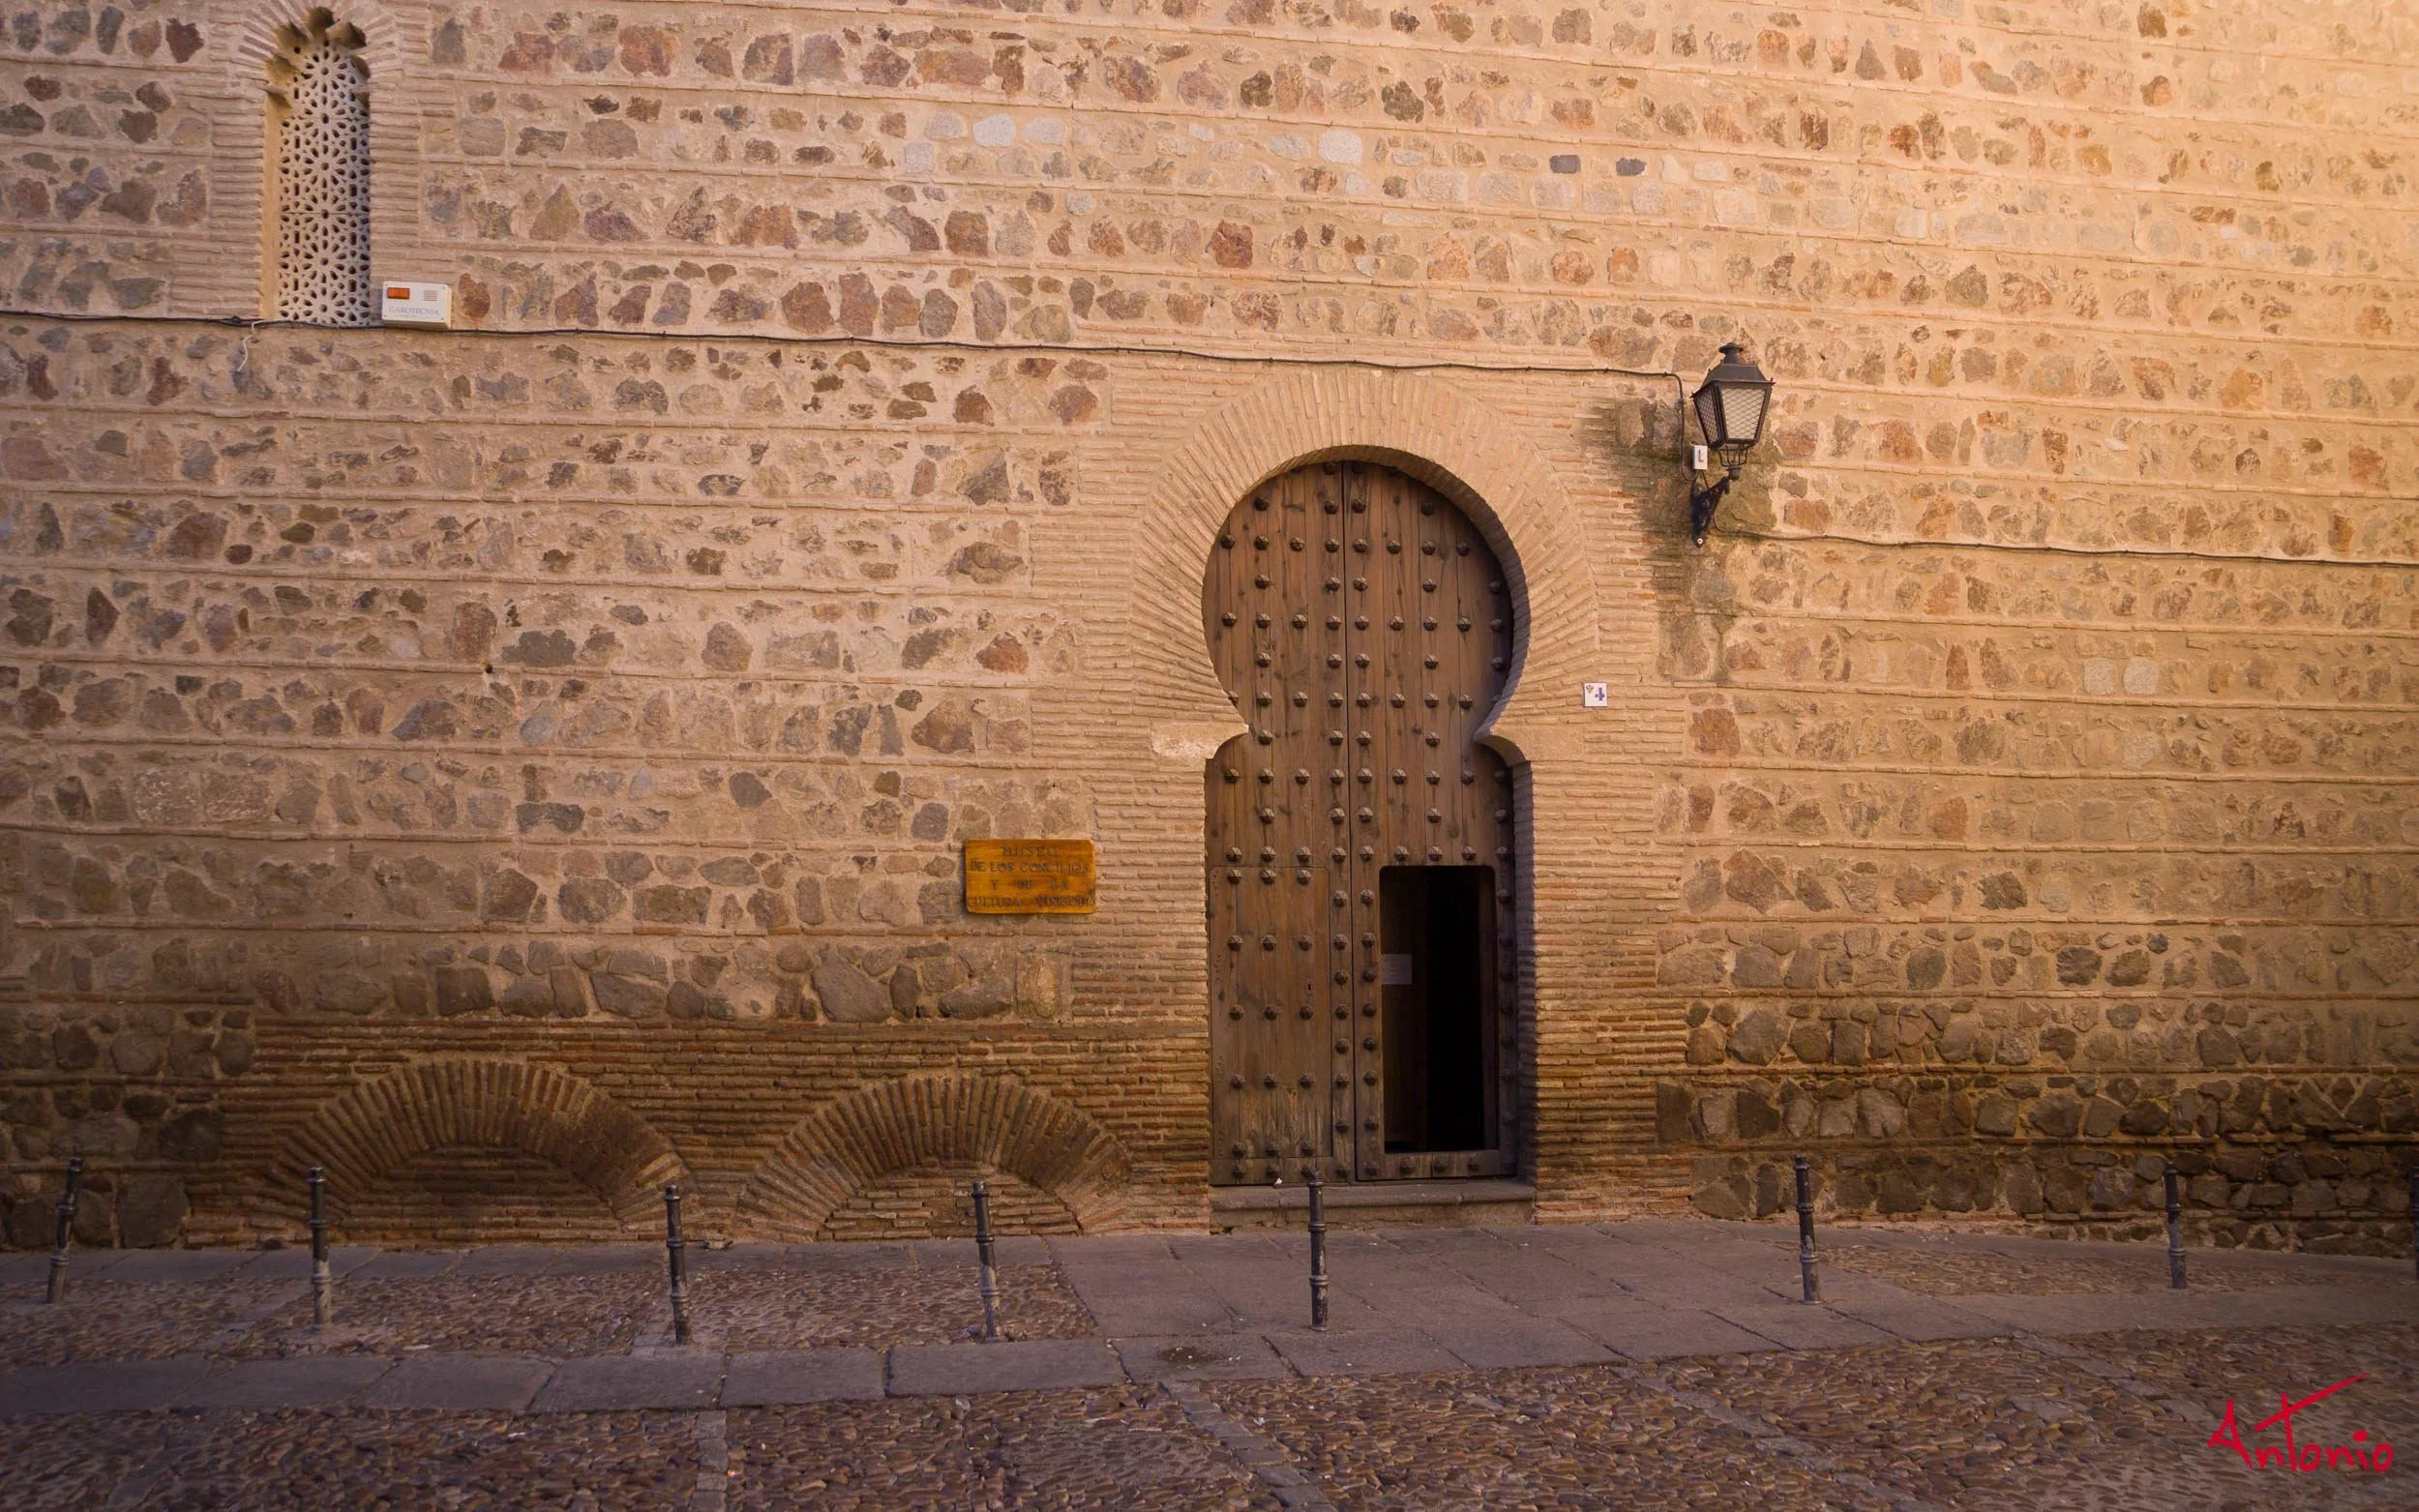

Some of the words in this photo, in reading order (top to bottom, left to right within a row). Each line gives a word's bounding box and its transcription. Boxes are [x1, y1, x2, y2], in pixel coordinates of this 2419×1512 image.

[1595, 687, 1605, 701] 4
[1002, 845, 1060, 857] MUSEO
[971, 861, 985, 873] DE
[990, 861, 1014, 873] LOS
[1020, 862, 1090, 875] CONCILIOS
[992, 879, 999, 890] Y
[1017, 878, 1031, 890] DE
[1051, 878, 1069, 891] LA
[968, 895, 1023, 907] CULTURA
